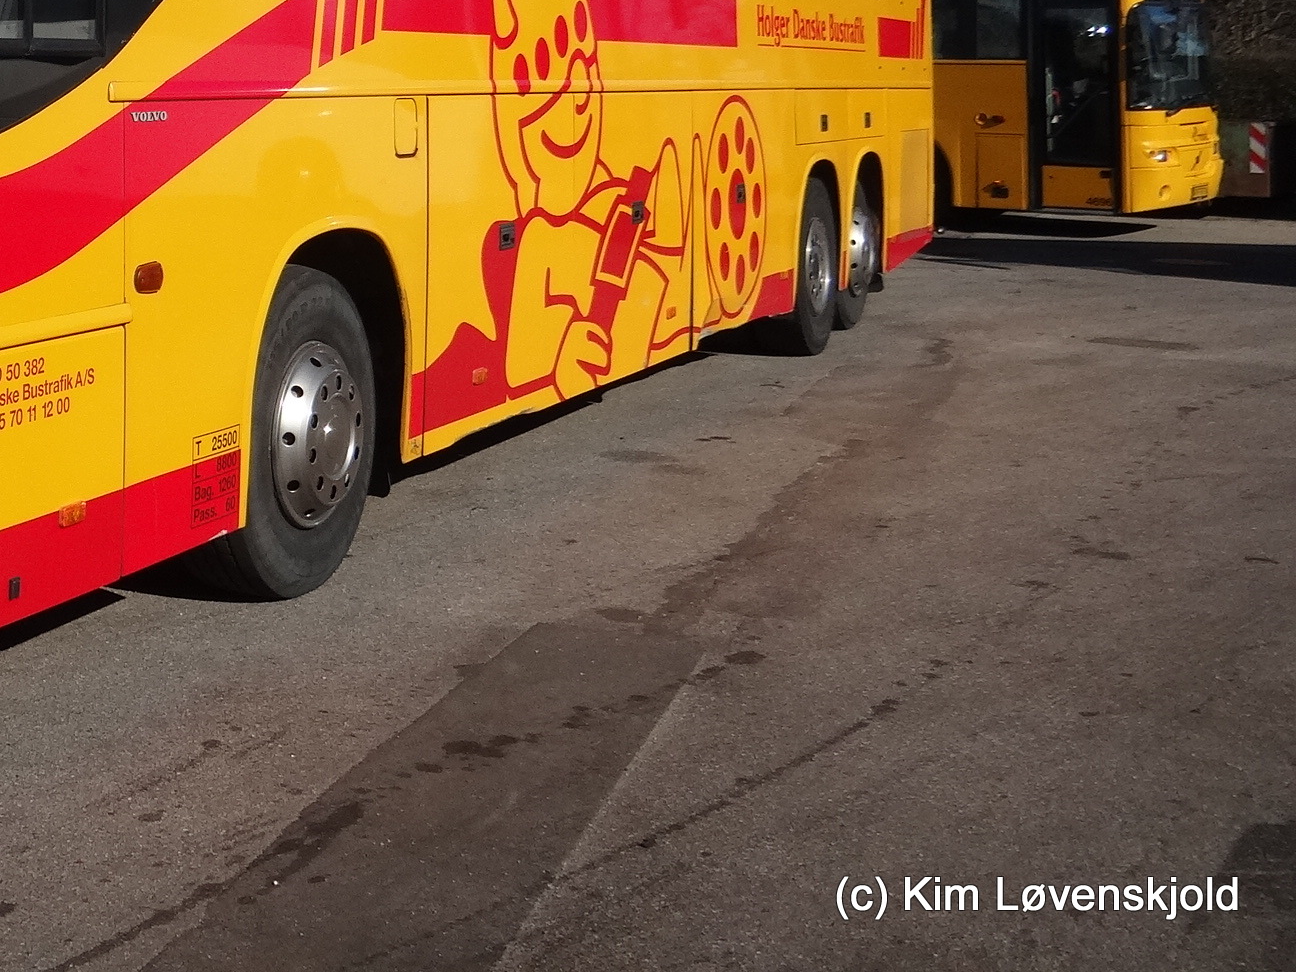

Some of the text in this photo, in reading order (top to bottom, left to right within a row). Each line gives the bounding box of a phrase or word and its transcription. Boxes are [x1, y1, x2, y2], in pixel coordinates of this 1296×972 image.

[756, 4, 865, 47] Holger Danske Bustrafik
[130, 110, 168, 122] VOLVO
[6, 362, 20, 381] 50
[23, 357, 45, 377] 382
[22, 373, 73, 400] Bustrafik
[75, 368, 95, 388] A/S
[10, 408, 23, 427] 70
[27, 404, 37, 423] 11
[42, 401, 53, 418] 12
[56, 396, 70, 415] 00
[195, 430, 237, 456] T 25500
[194, 485, 214, 501] Bag.
[193, 506, 217, 522] Pass.
